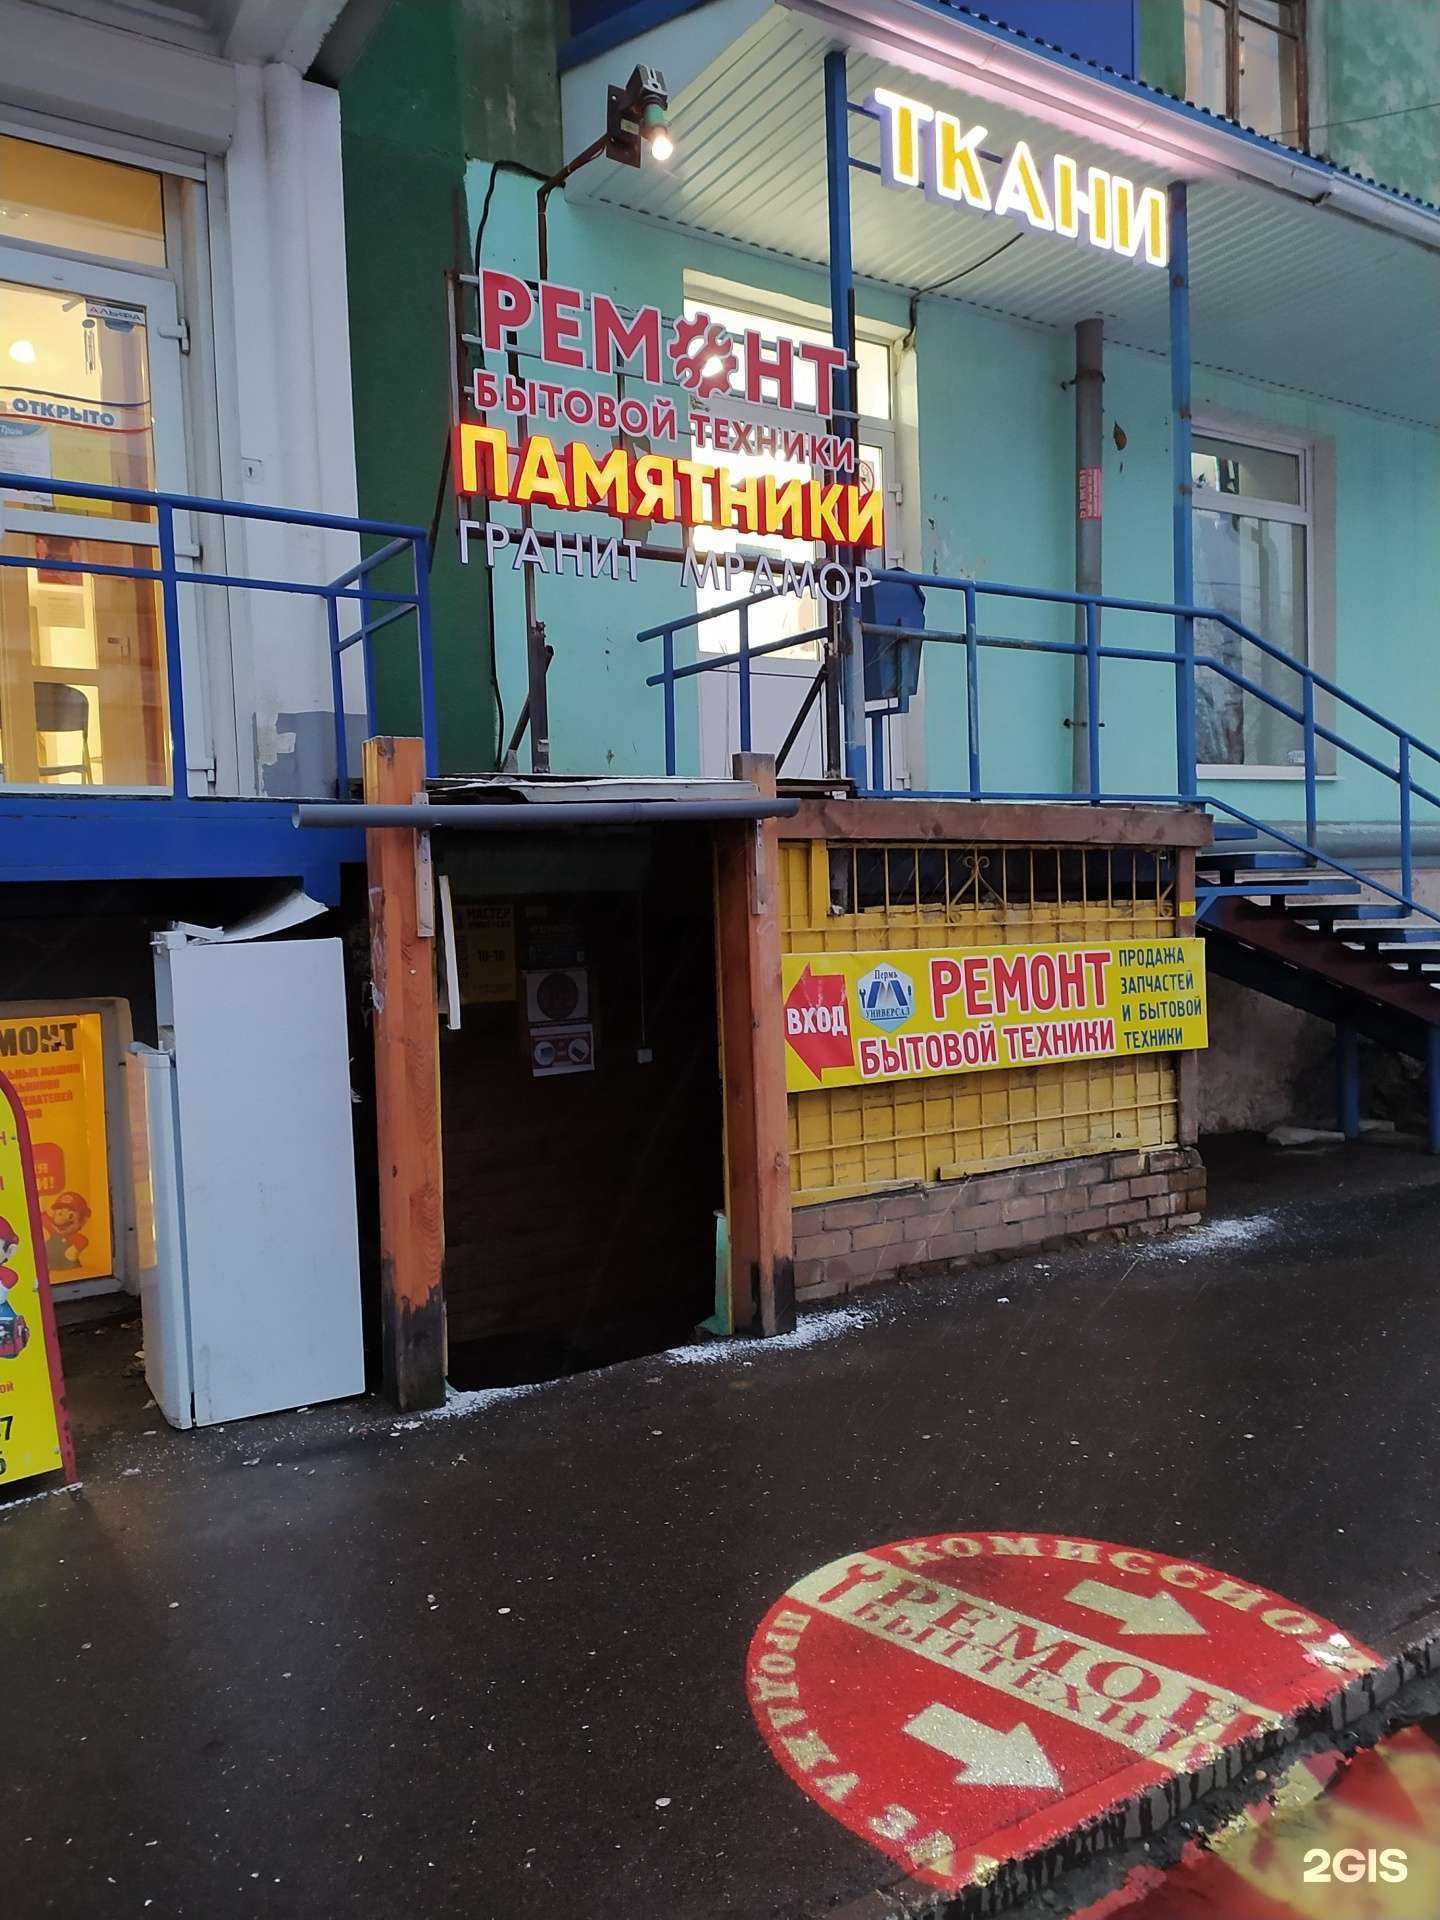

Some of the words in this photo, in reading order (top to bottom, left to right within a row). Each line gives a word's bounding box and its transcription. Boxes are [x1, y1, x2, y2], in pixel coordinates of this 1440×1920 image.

[874, 87, 1169, 267] ТКАНИ
[480, 270, 847, 416] РЕМОНТ
[12, 398, 115, 426] ОТКРЫТО
[474, 368, 677, 442] БЫТОВОЙ
[689, 412, 858, 472] ТЕХНИКИ
[457, 423, 884, 548] ПАМЯТНИКИ
[458, 519, 642, 582] ГРАНИТ
[681, 547, 873, 603] МРАМОР
[930, 952, 1111, 1019] РЕМОНТ
[1119, 946, 1185, 968] ПРОДАЖА
[1121, 970, 1194, 995] ЗАПЧАСТЕЙ
[787, 1005, 848, 1036] ВХОД
[1122, 1007, 1131, 1022] И
[1139, 996, 1202, 1018] БЫТОВОЙ
[1124, 1026, 1183, 1049] ТЕХНИКИ
[859, 1027, 997, 1077] БЫТОВОЙ
[1002, 1018, 1115, 1062] ТЕХНИКИ
[749, 1609, 860, 1803] ПРОДАЖА
